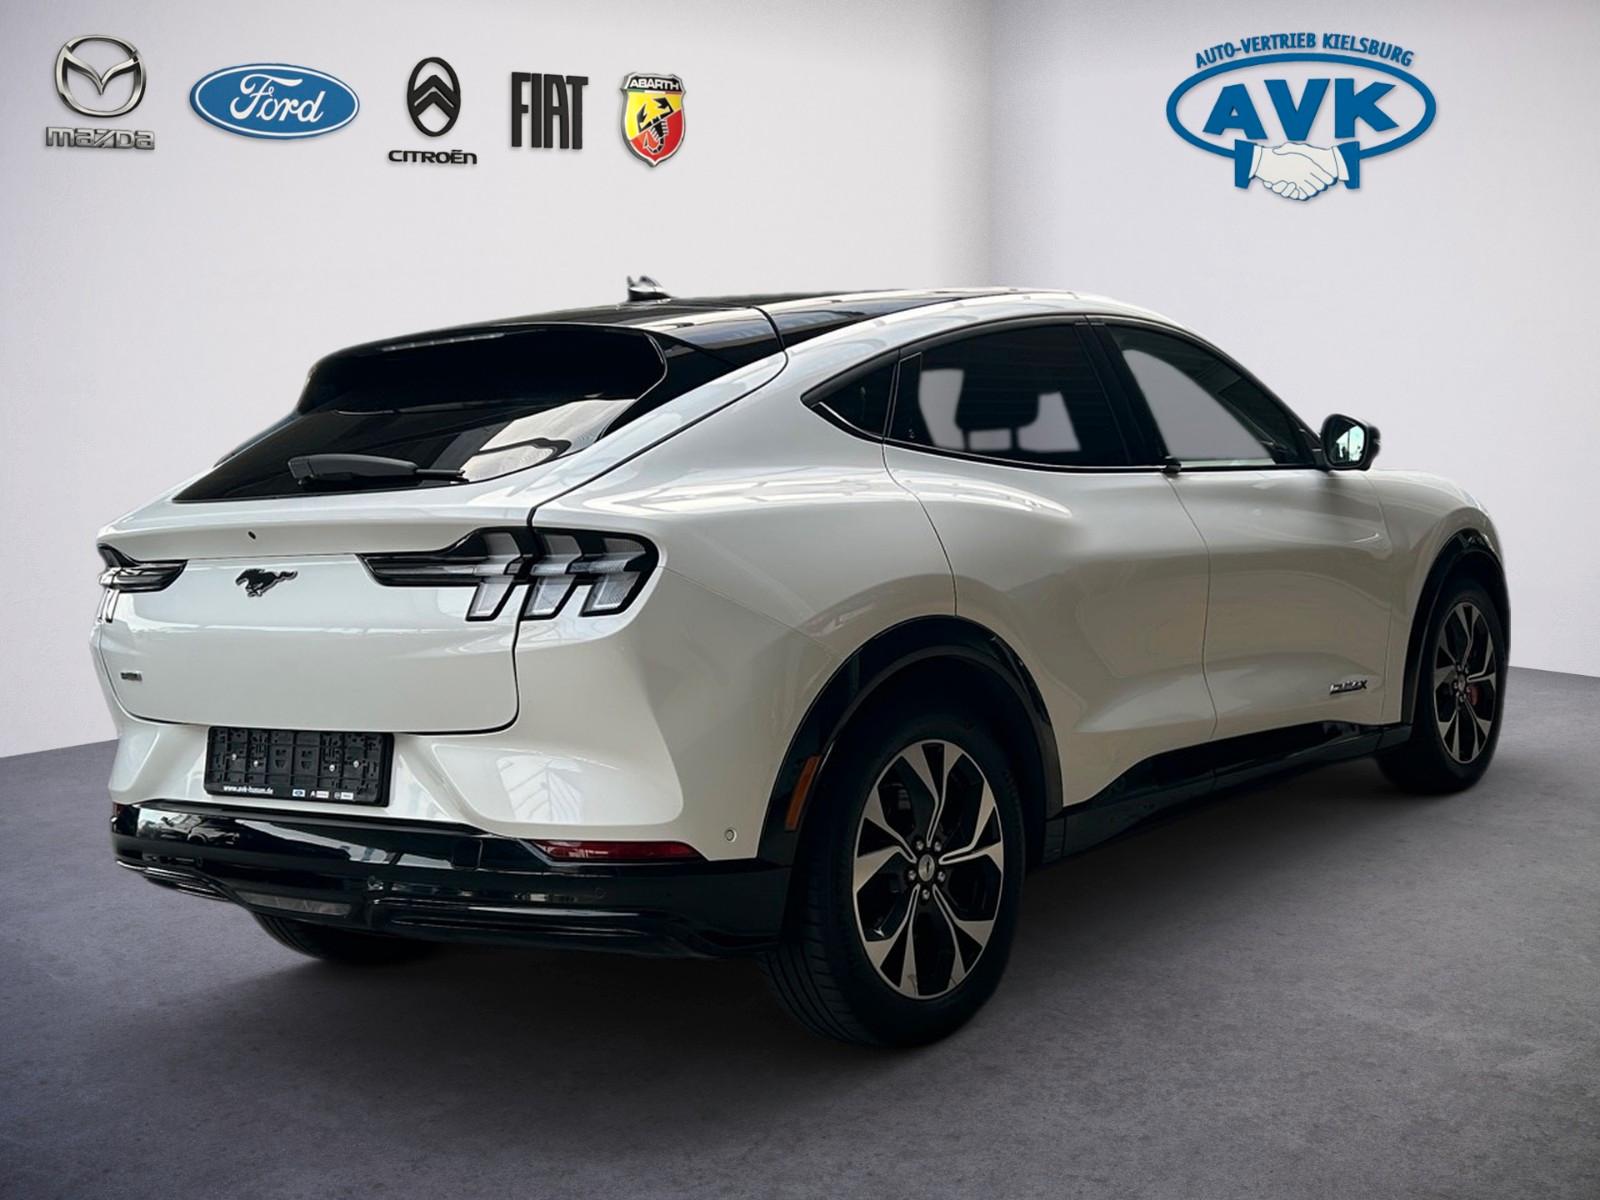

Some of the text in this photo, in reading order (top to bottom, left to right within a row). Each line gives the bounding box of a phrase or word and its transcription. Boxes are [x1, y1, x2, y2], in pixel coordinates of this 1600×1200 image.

[1196, 32, 1414, 68] AUTO-VERTRIEB KIELSBURG
[229, 73, 326, 123] Ford
[629, 79, 679, 91] ABARTH
[1202, 78, 1400, 141] AVK
[511, 71, 589, 150] FIAT
